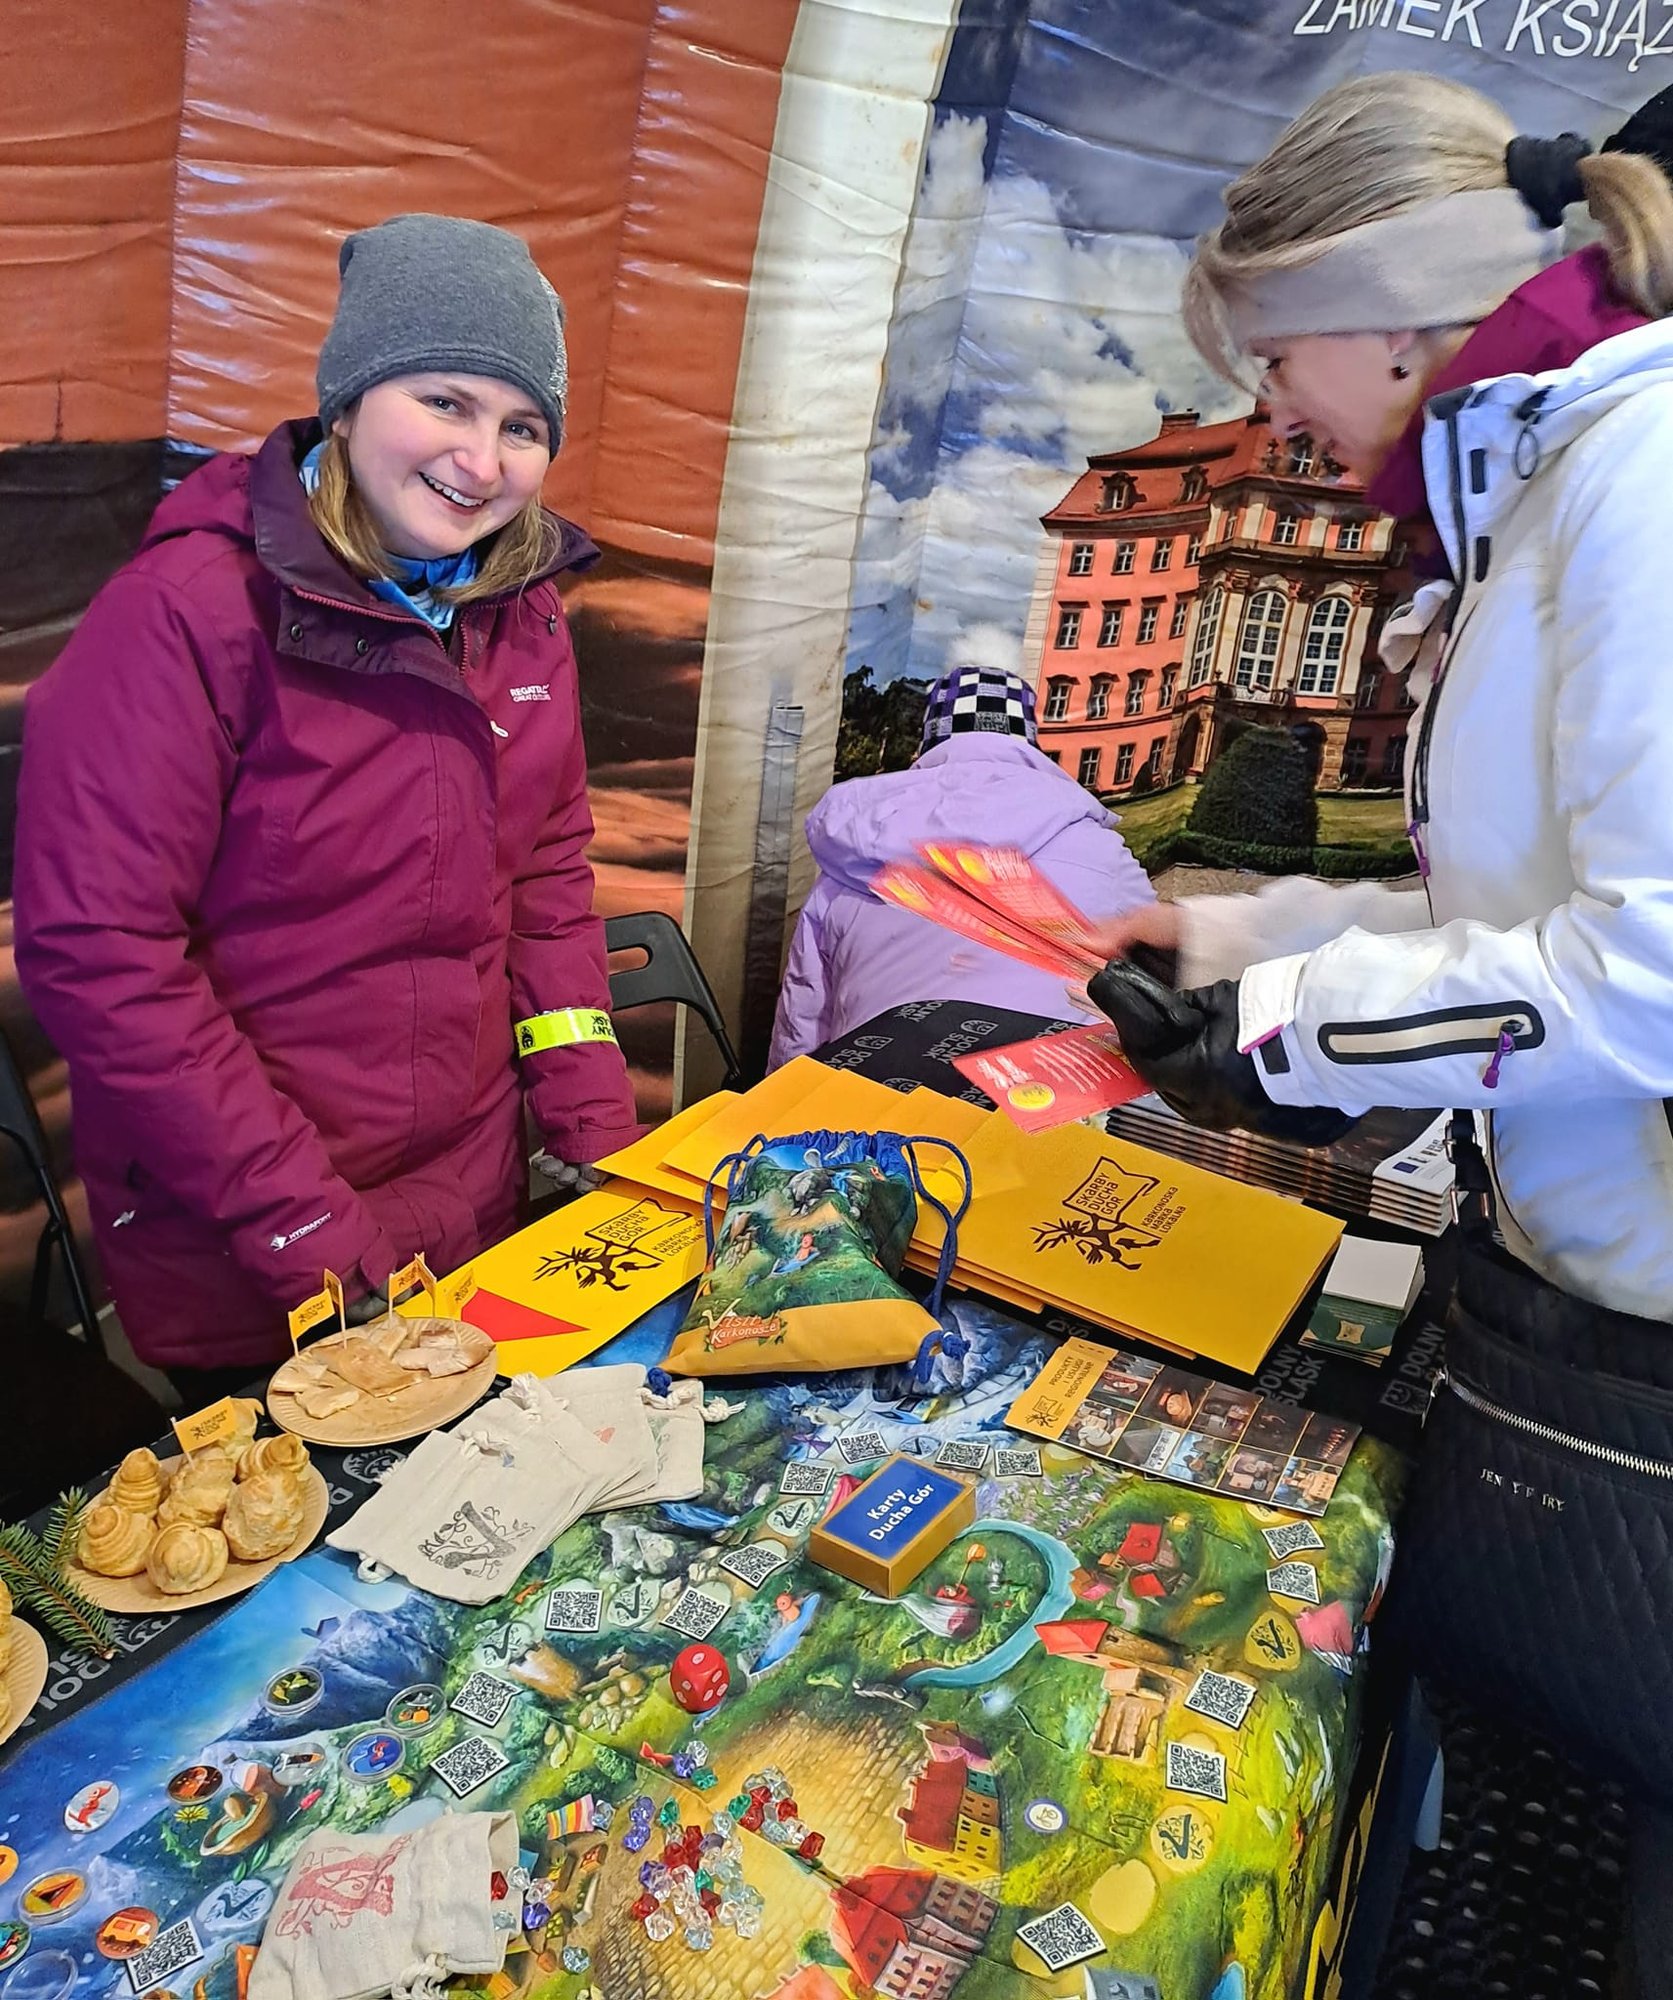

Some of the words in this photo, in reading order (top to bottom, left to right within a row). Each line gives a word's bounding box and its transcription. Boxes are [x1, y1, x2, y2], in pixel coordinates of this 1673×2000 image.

[866, 1488, 908, 1520] Karty
[868, 1505, 914, 1541] Ducha
[908, 1484, 935, 1505] Gór
